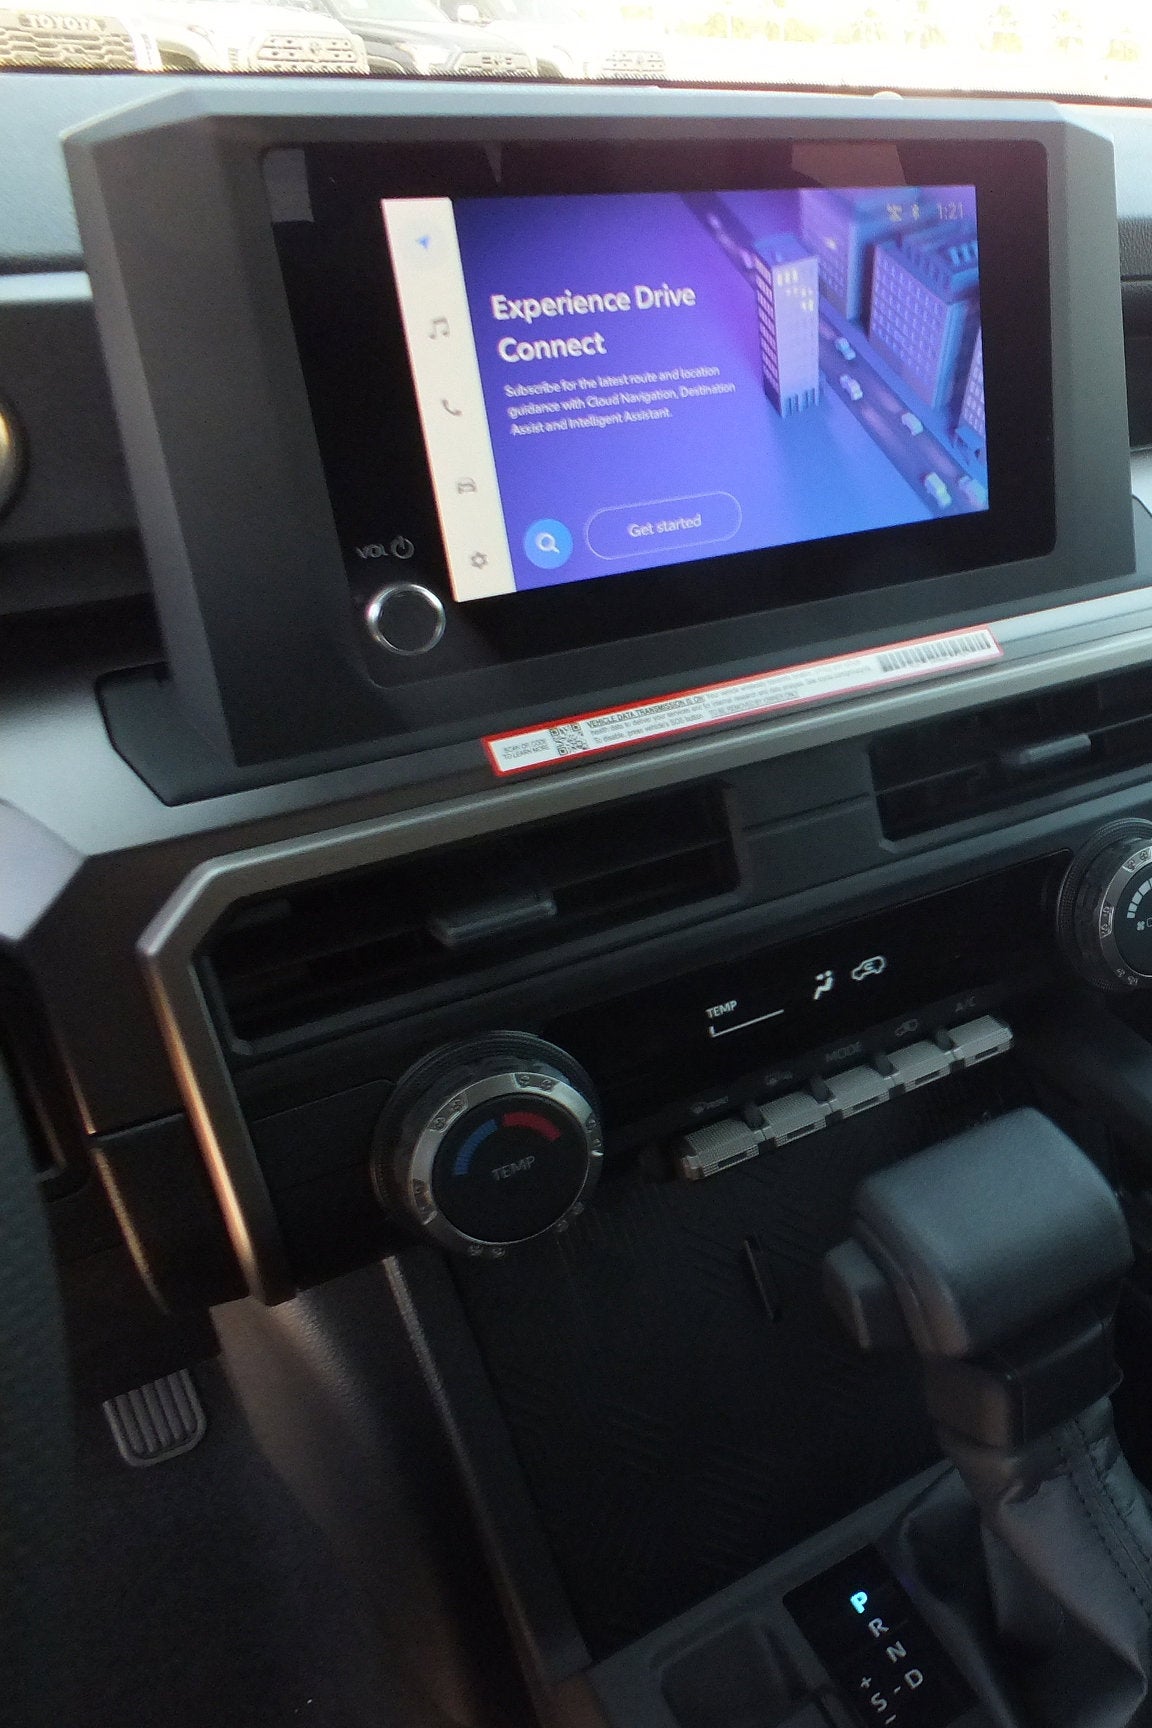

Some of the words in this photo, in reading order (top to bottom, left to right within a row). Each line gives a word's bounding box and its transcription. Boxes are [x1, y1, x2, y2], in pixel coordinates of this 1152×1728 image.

[25, 14, 103, 32] TOYOTA
[937, 202, 963, 220] 1:21
[490, 289, 631, 324] Experience
[634, 282, 697, 310] Drive
[498, 331, 607, 363] Connect
[504, 381, 560, 397] Subscribe
[560, 379, 577, 391] for
[578, 377, 597, 390] the
[598, 374, 629, 388] latest
[630, 372, 657, 384] route
[659, 368, 680, 381] and
[680, 366, 721, 379] location
[507, 402, 560, 419] guidance
[561, 397, 586, 411] with
[586, 393, 620, 408] Cloud
[680, 382, 736, 398] Destination
[510, 422, 545, 436] Assist
[545, 419, 568, 432] and
[568, 413, 624, 429] Intelligent
[628, 522, 654, 537] Get
[657, 513, 702, 533] started
[356, 544, 389, 559] VOL
[616, 712, 634, 723] DATA
[705, 1000, 738, 1019] TEMP
[491, 1155, 535, 1181] TEMP
[850, 1591, 868, 1614] P
[868, 1617, 890, 1639] R
[886, 1640, 907, 1663] N
[904, 1668, 924, 1689] D
[870, 1692, 888, 1712] S
